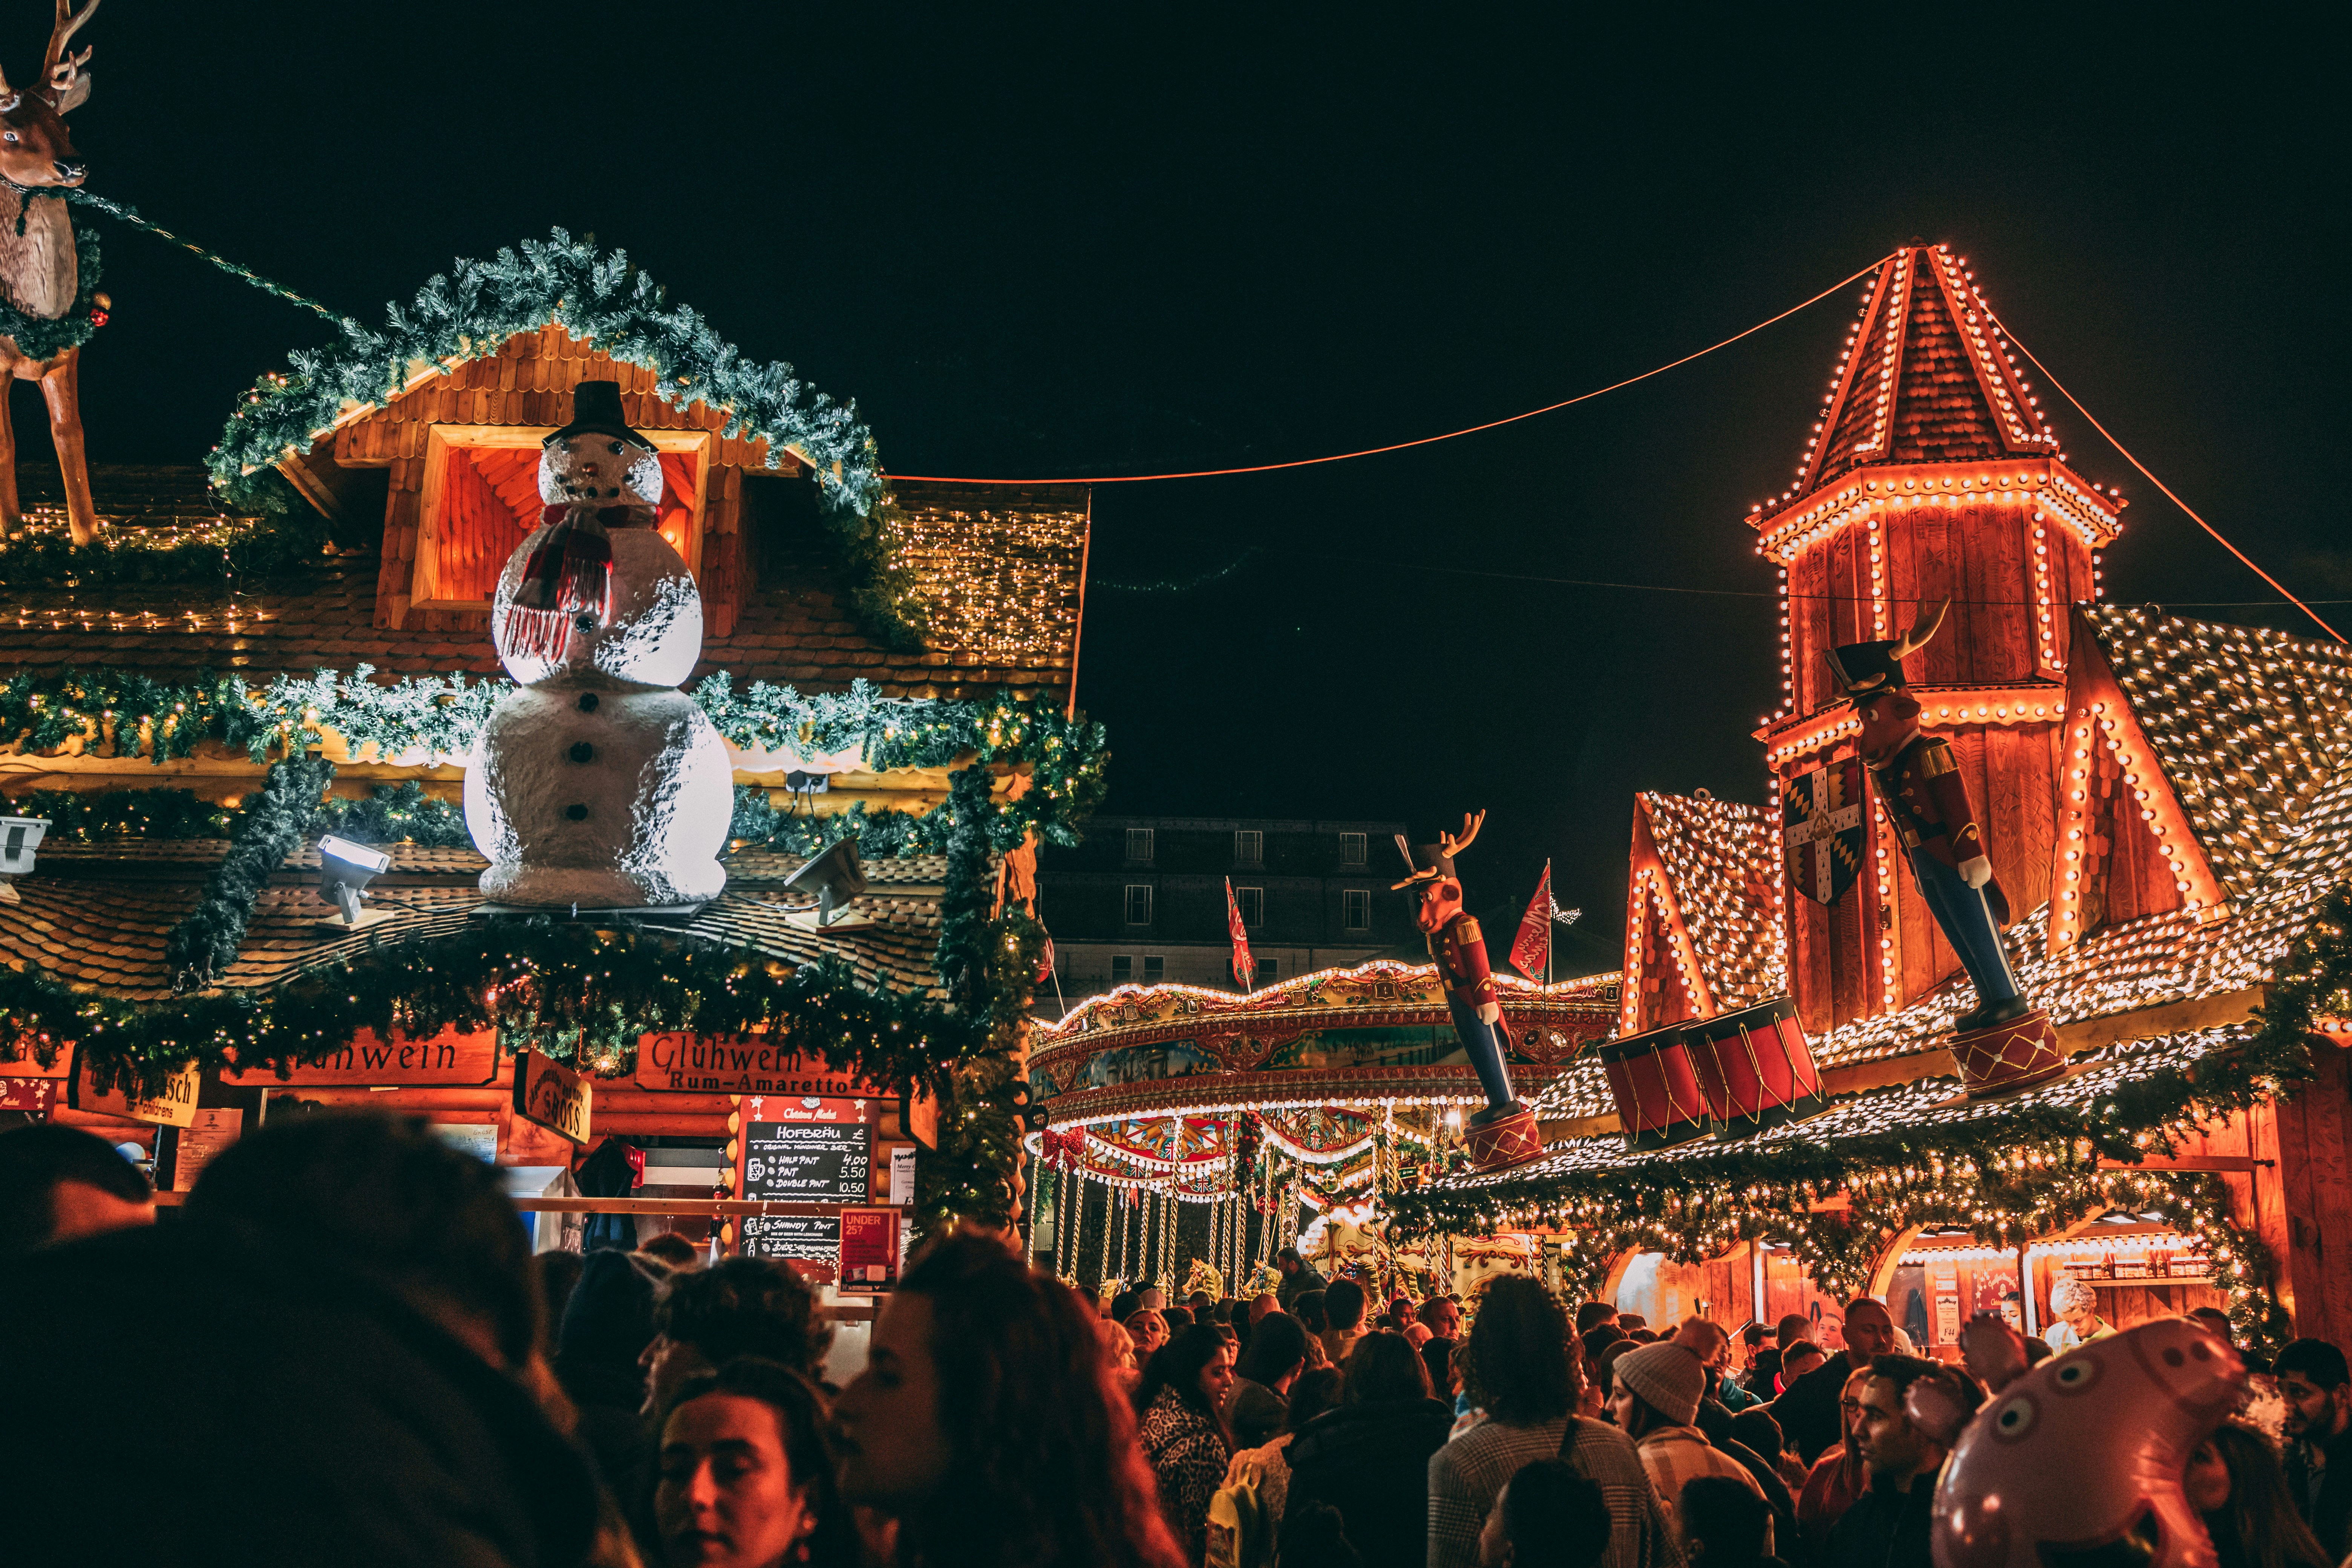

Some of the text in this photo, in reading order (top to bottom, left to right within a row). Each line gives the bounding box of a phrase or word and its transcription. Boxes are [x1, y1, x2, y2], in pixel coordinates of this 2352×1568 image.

[776, 1126, 841, 1139] HOFBRÄU
[778, 1153, 868, 1166] HALF PINT 4.00
[778, 1166, 866, 1178] PINT 5.50
[775, 1179, 865, 1193] DOUBLE PINT 10.50
[771, 1219, 835, 1232] SHANDY PINT
[846, 1215, 881, 1225] UNDER
[846, 1225, 863, 1235] 25?
